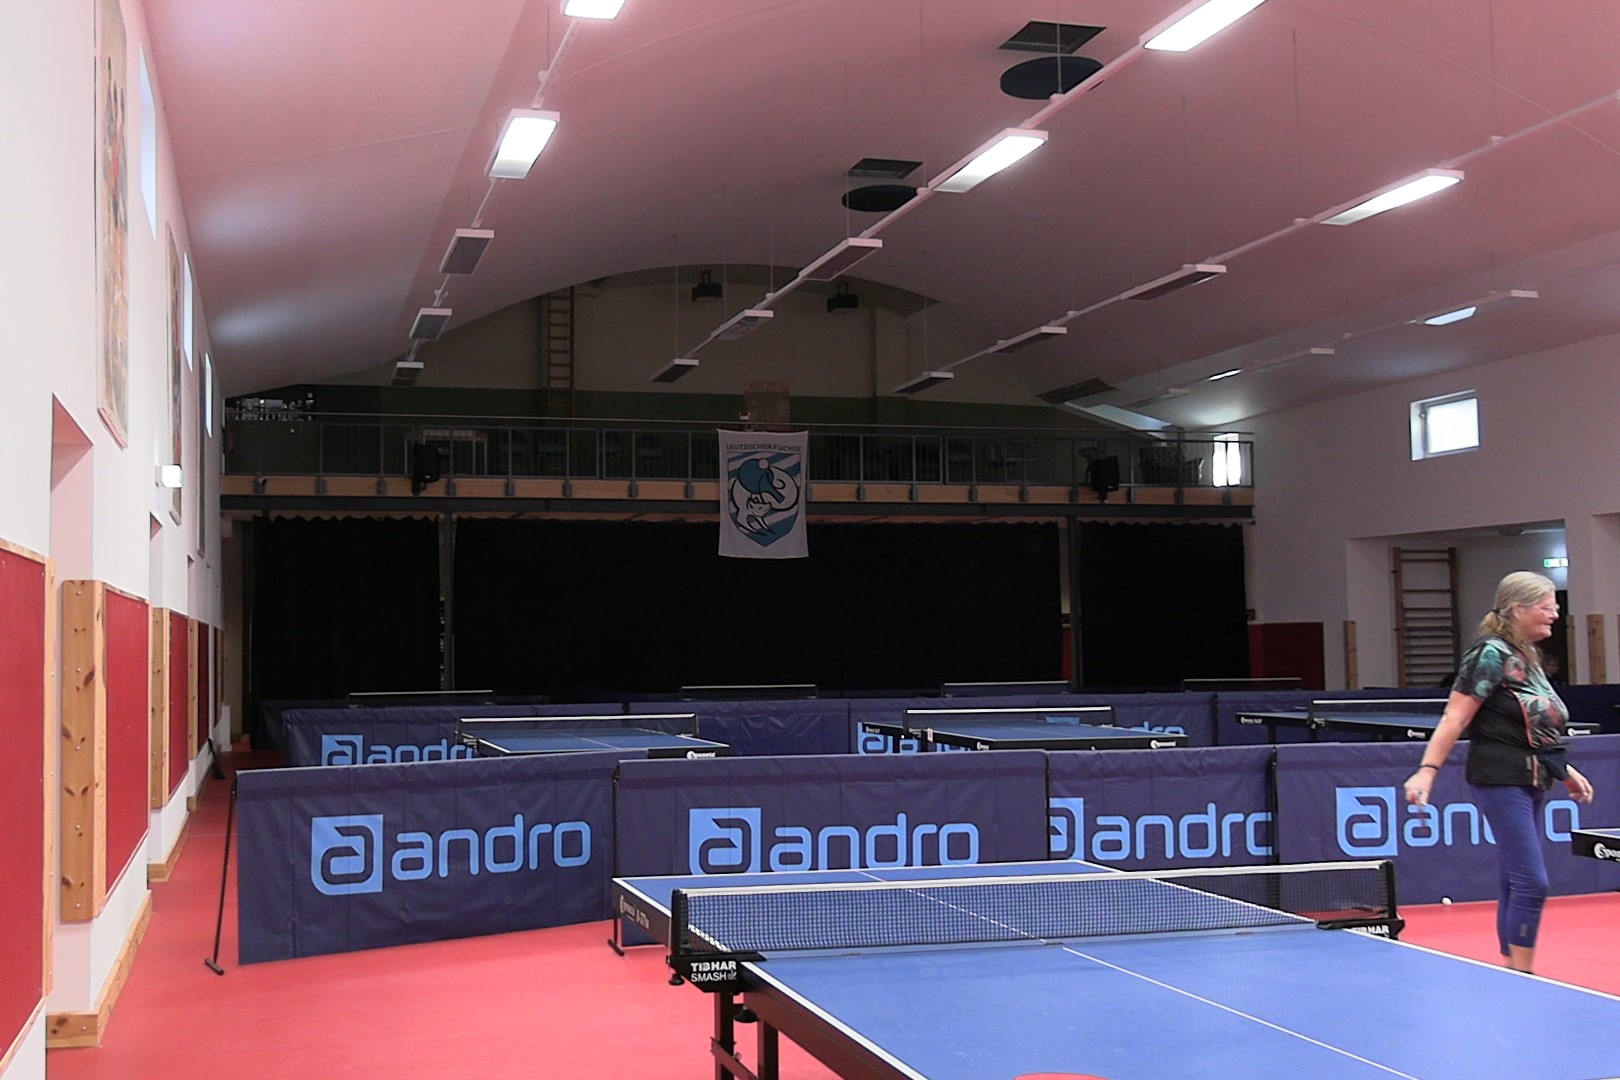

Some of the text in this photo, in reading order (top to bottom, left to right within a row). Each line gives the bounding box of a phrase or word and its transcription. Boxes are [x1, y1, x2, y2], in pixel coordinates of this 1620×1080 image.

[391, 813, 592, 881] andro
[769, 812, 980, 872] andro
[690, 961, 737, 972] TIBHAR
[690, 972, 727, 982] SMASH
